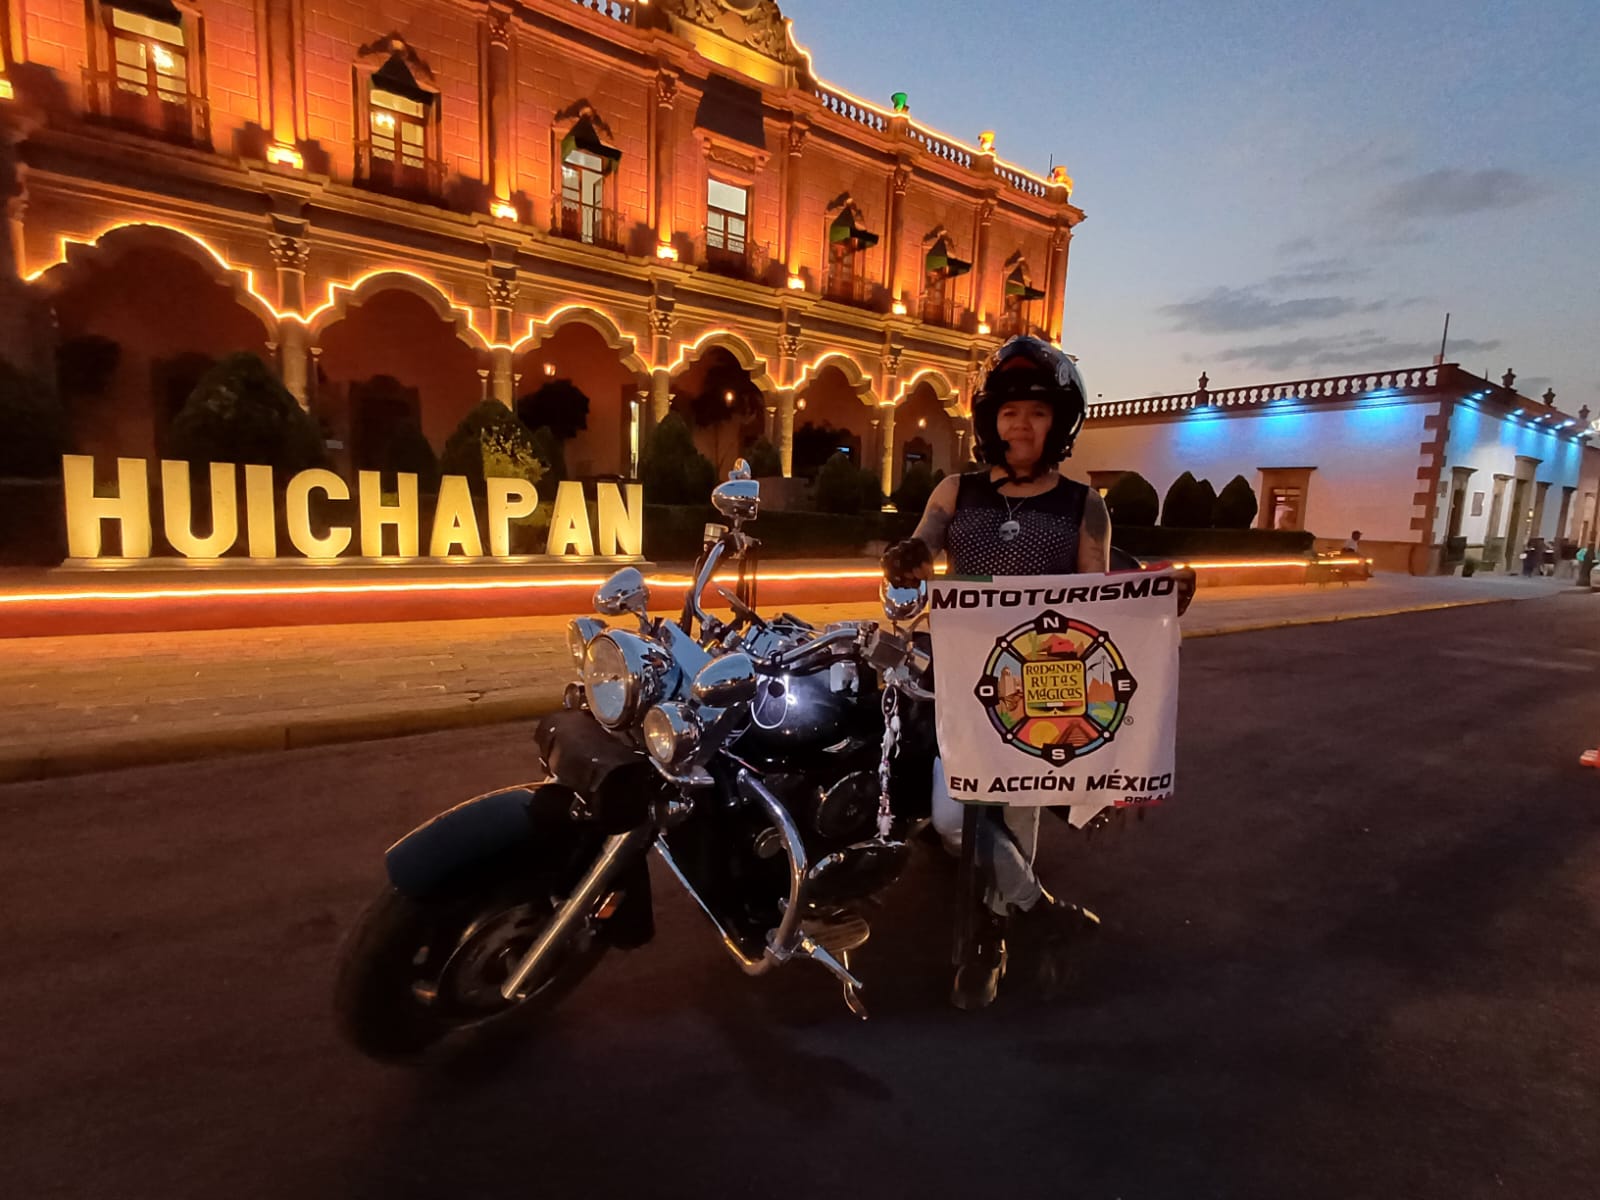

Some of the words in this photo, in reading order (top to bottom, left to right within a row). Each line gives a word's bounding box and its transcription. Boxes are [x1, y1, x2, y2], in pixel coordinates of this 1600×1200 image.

[63, 454, 643, 559] HUICHAPAN
[931, 576, 1175, 609] MOTOTURISMO
[1042, 616, 1060, 629] N
[980, 685, 994, 697] O
[1117, 679, 1132, 692] E
[1051, 748, 1066, 760] S
[950, 776, 978, 792] EN
[988, 771, 1075, 793] ACCIÓN
[1085, 769, 1172, 792] MÉXICO
